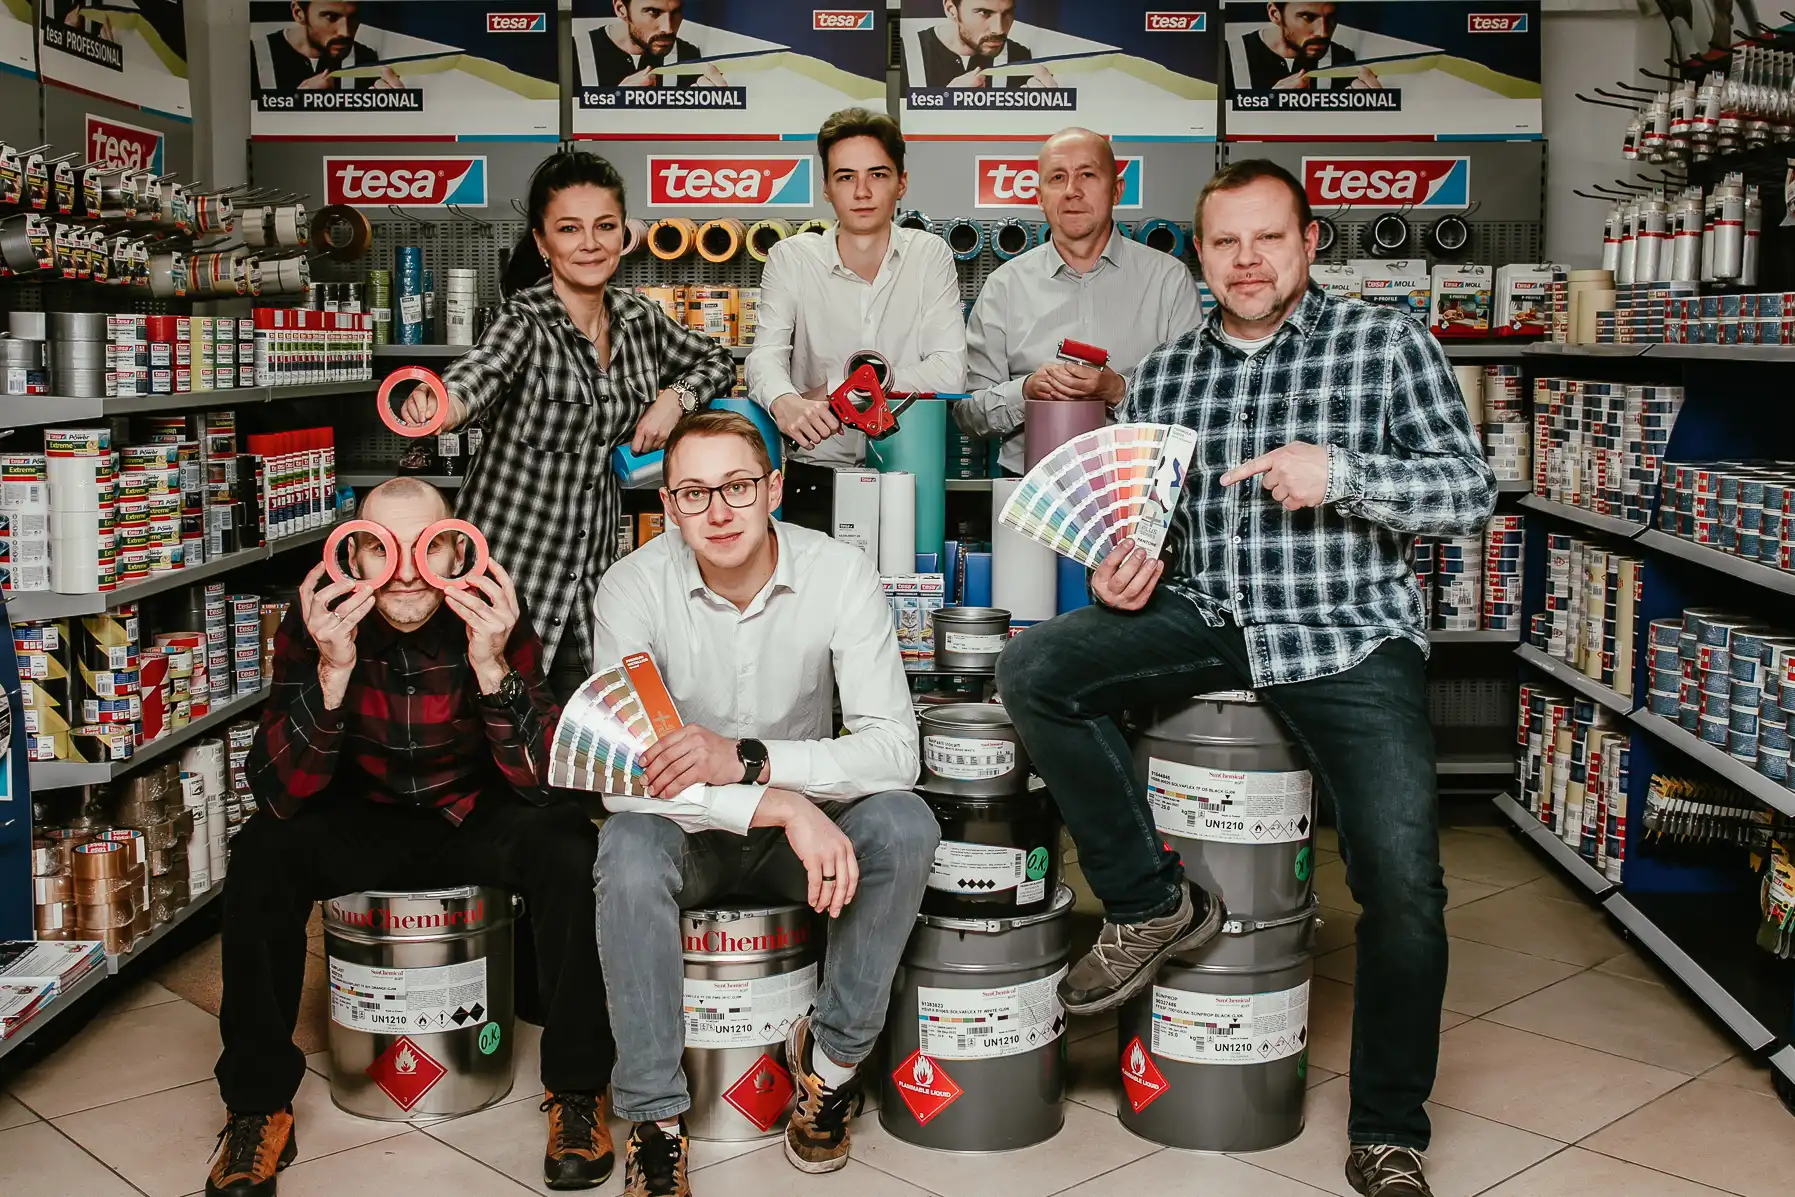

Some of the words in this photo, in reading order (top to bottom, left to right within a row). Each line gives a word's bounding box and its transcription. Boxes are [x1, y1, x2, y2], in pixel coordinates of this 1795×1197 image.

[491, 16, 528, 29] tesa
[818, 14, 857, 27] tesa
[1150, 14, 1188, 28] tesa
[1472, 16, 1510, 29] tesa
[66, 31, 121, 67] PROFESSIONAL
[303, 93, 418, 108] PROFESSIONAL
[625, 90, 742, 106] PROFESSIONAL
[953, 91, 1072, 107] PROFESSIONAL
[1278, 93, 1397, 108] PROFESSIONAL
[986, 164, 1038, 198] te
[1205, 819, 1244, 831] UN1210
[331, 900, 484, 930] SunChemical
[371, 1015, 407, 1024] UN1210
[715, 1024, 753, 1034] UN1210
[480, 1023, 500, 1050] O.K.
[984, 1035, 1019, 1047] UN1210
[1215, 1043, 1252, 1052] UN1210
[898, 1080, 930, 1095] FLAMMABLE
[930, 1089, 951, 1098] LIQUID
